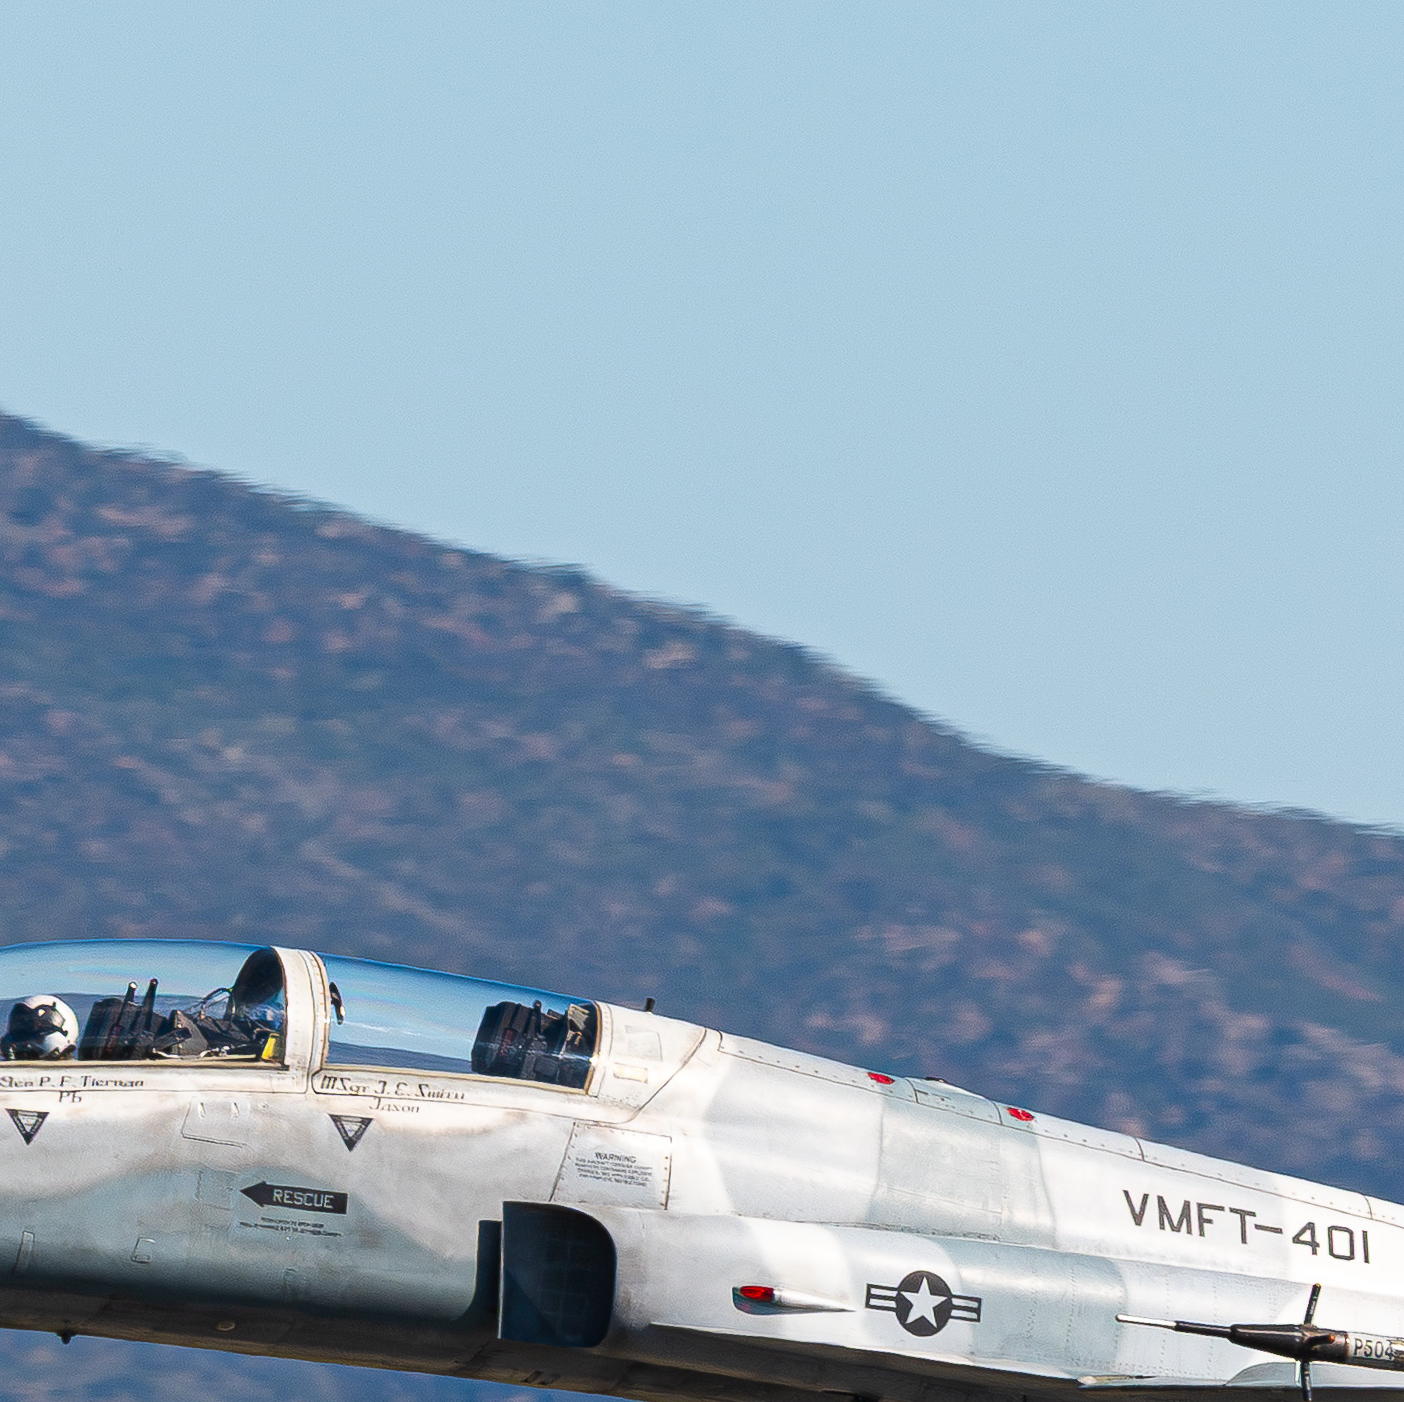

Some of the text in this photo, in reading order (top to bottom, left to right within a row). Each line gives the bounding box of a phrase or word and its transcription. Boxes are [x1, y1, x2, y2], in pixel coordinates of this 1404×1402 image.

[594, 1151, 637, 1164] WARNING
[272, 1188, 334, 1209] RESCUE
[1122, 1189, 1370, 1264] VMFT-401
